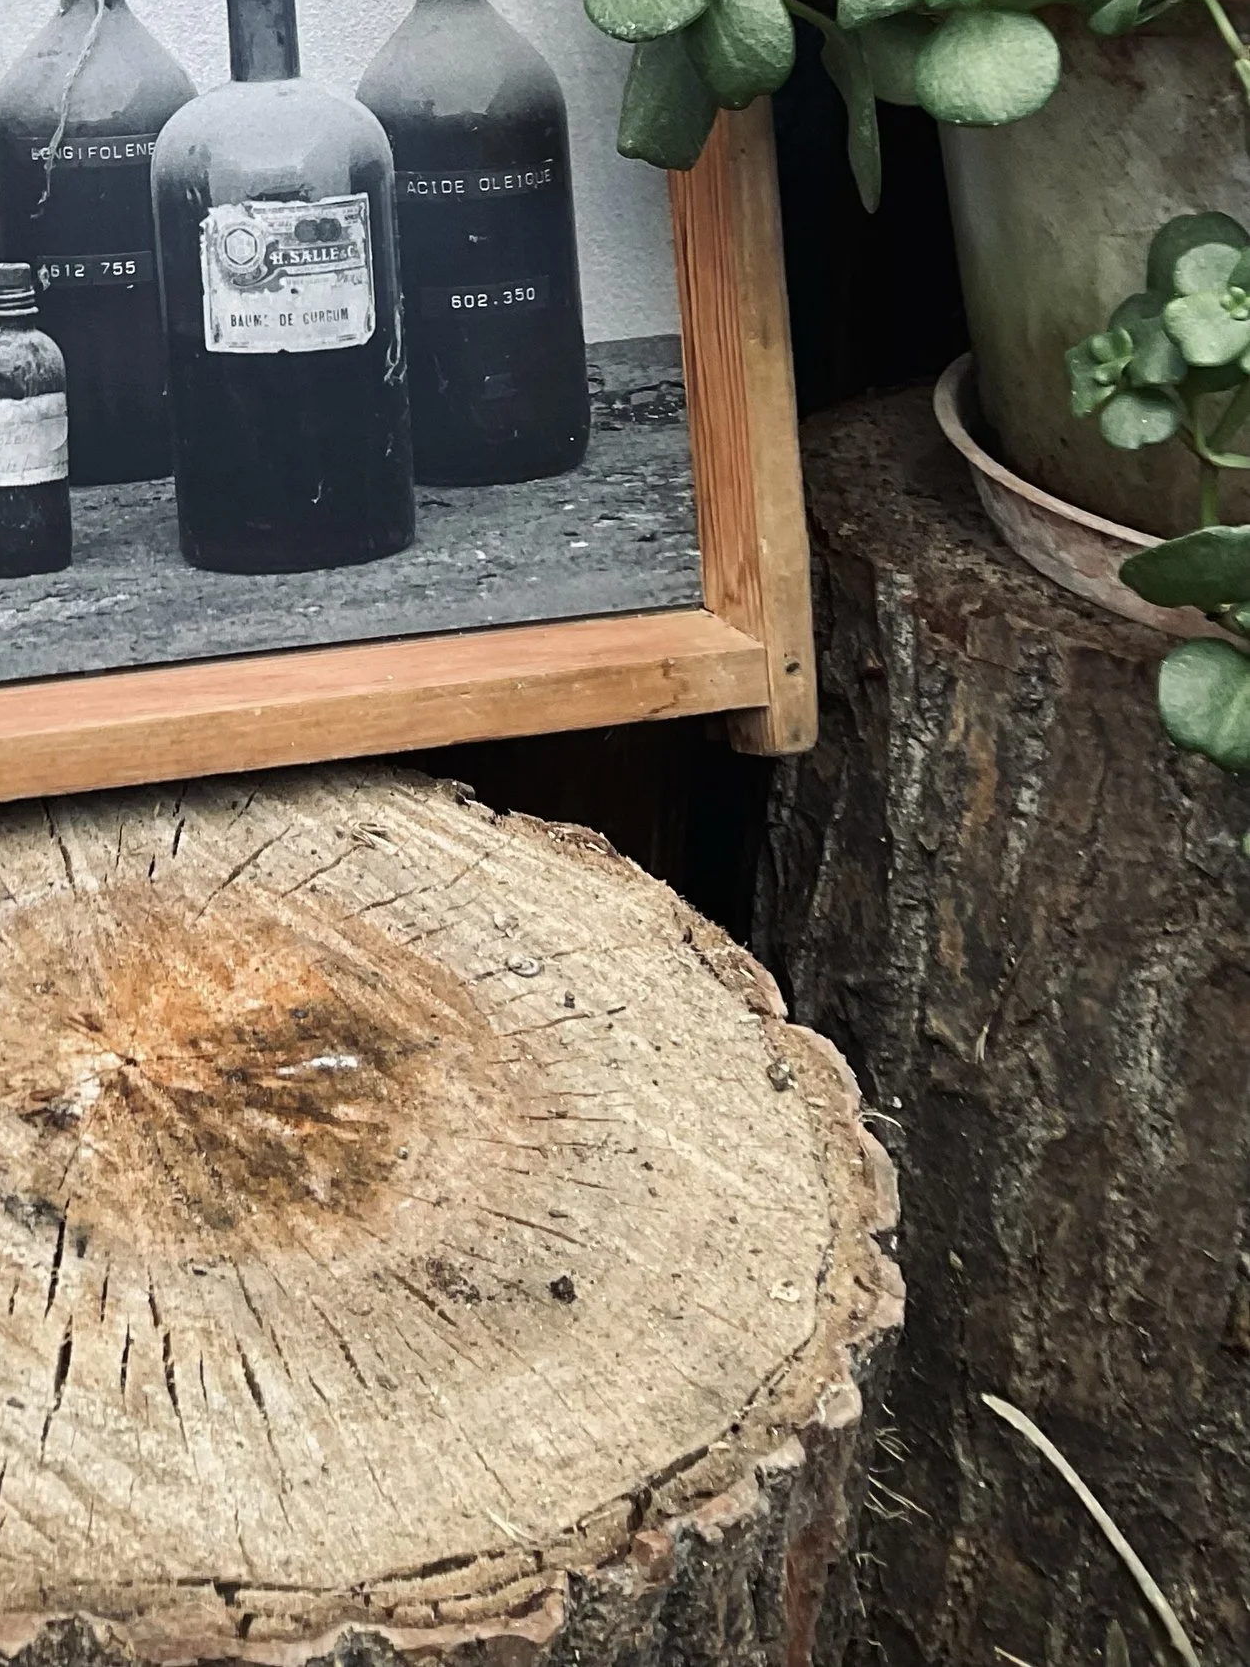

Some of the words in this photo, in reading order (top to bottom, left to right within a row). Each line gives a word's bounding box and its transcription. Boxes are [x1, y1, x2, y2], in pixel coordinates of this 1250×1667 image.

[407, 180, 465, 195] ACIDE
[50, 264, 85, 278] 612
[101, 260, 137, 276] 755
[451, 287, 536, 309] 602.350
[279, 312, 294, 327] DE
